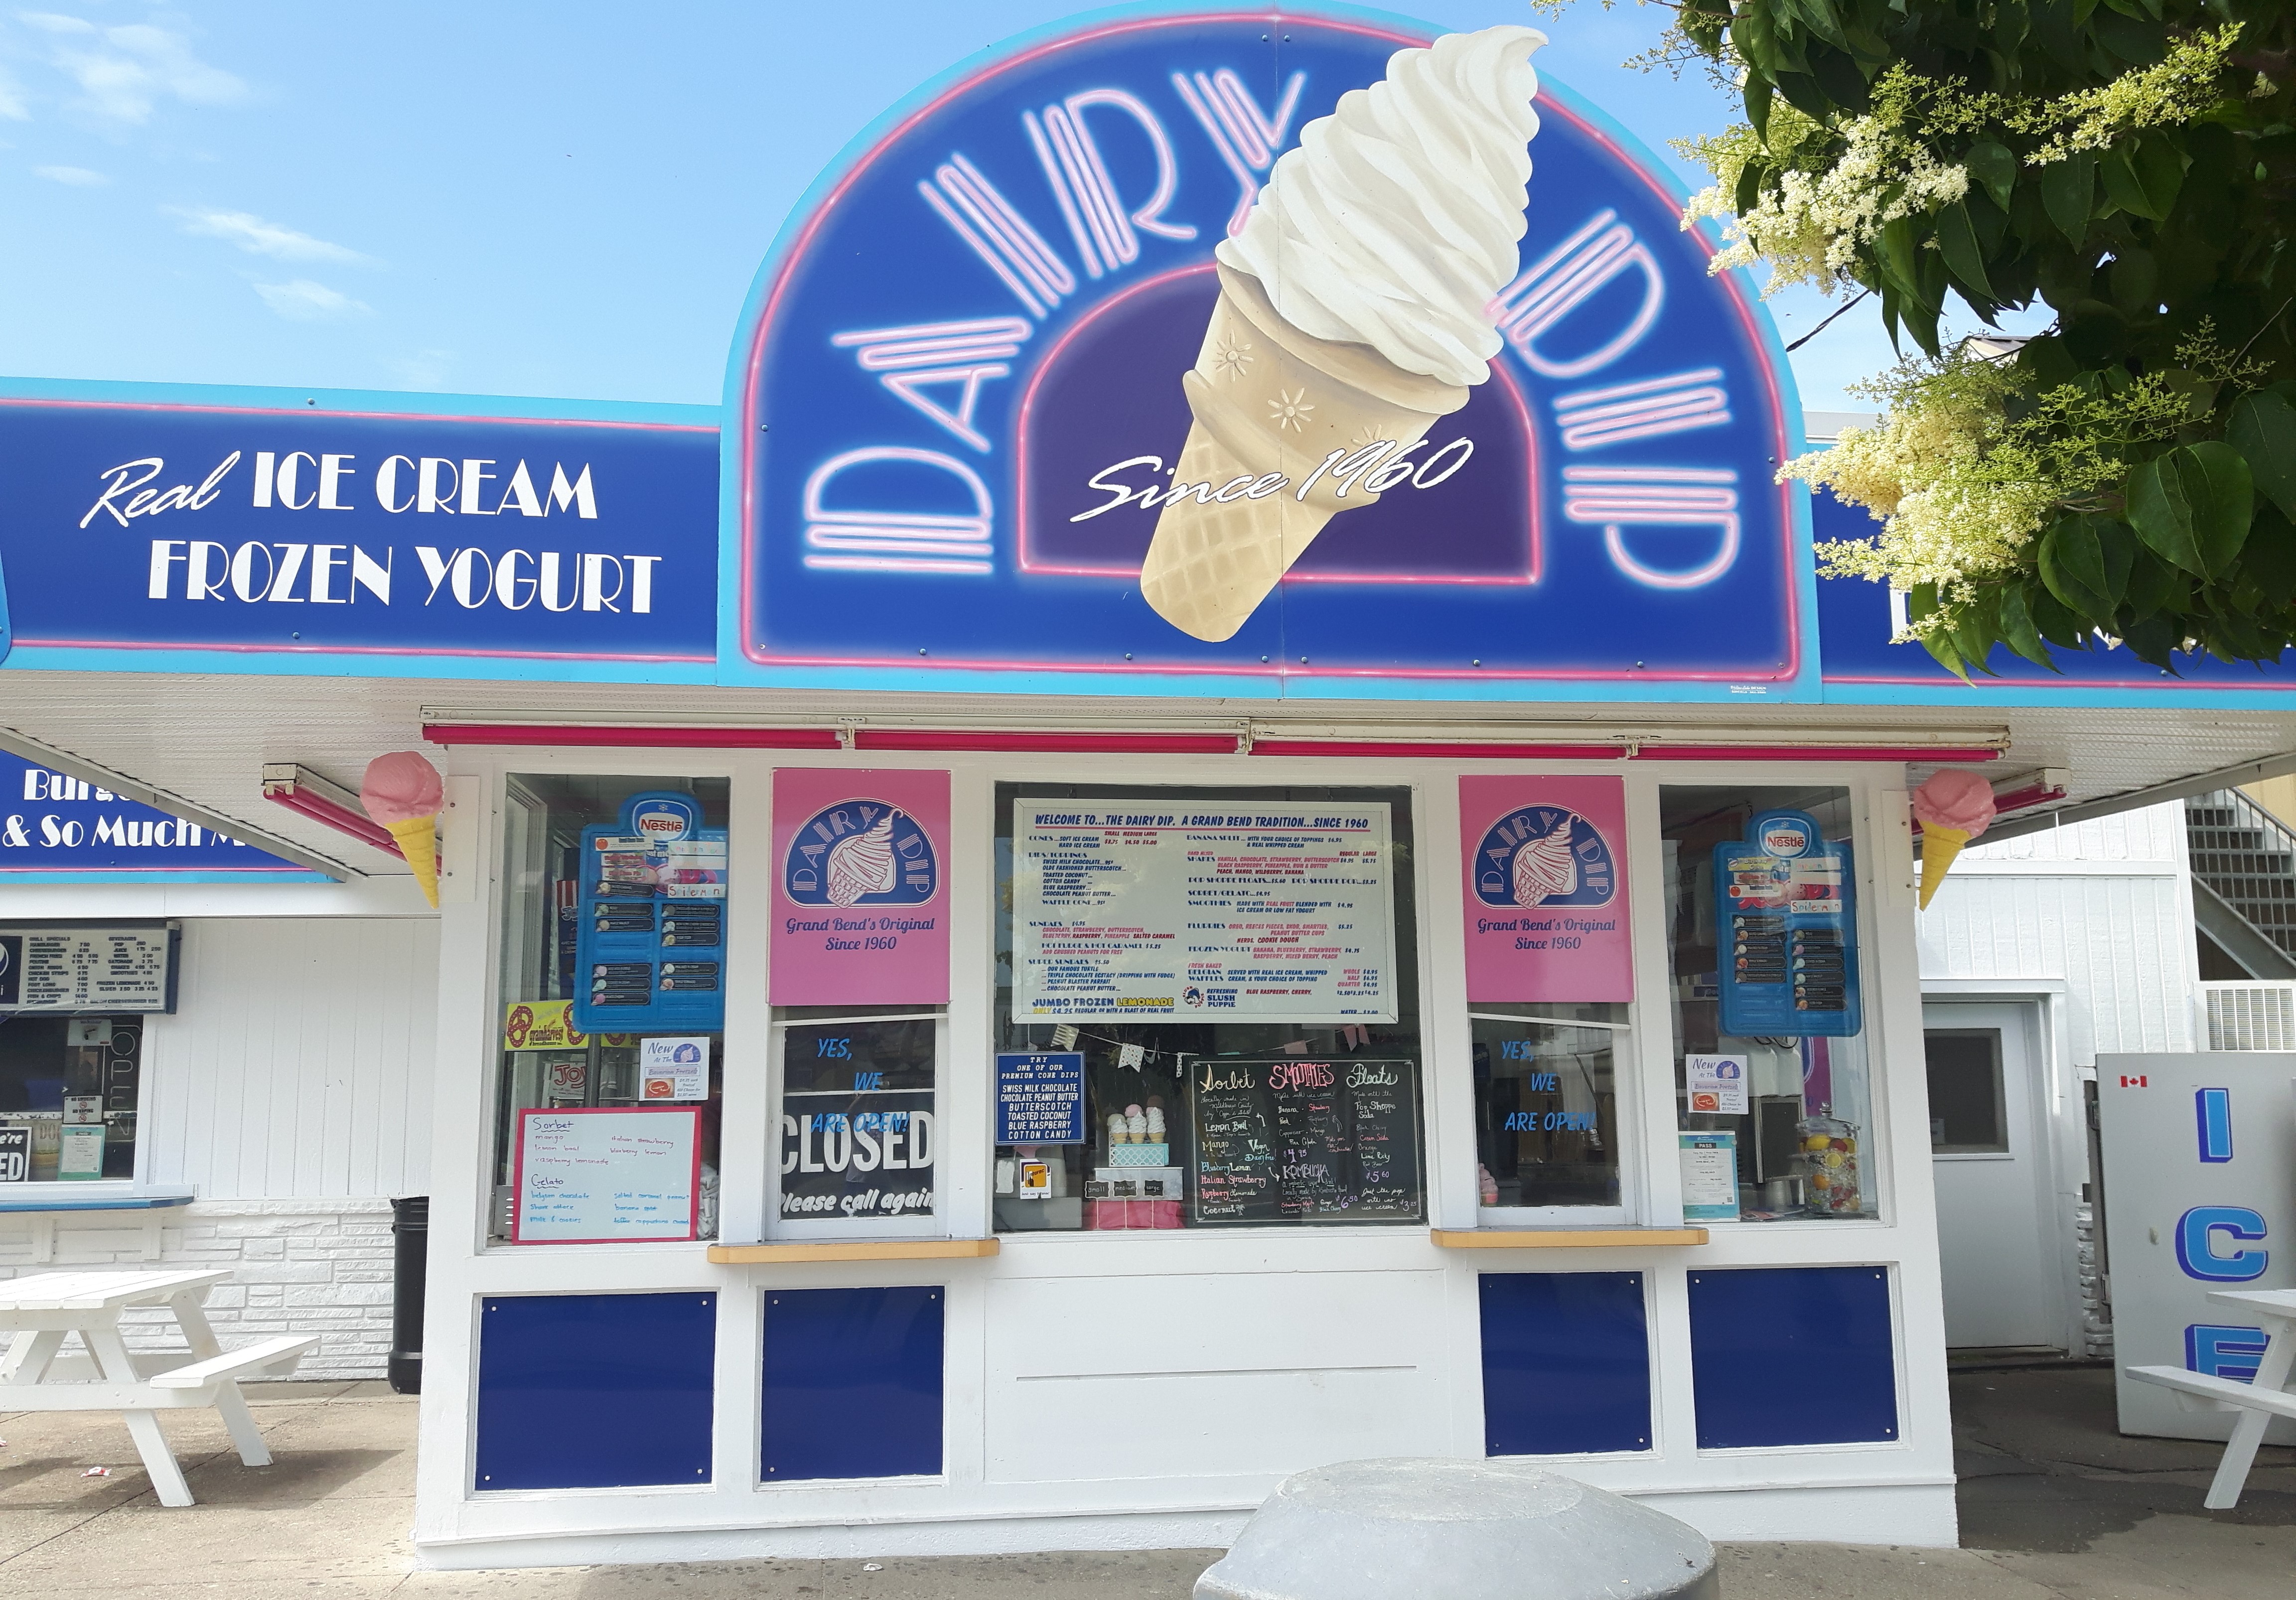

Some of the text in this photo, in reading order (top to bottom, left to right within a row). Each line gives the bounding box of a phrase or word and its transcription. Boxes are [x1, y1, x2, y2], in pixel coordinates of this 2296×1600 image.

[803, 67, 1739, 589] DAIRY DIP
[1070, 436, 1474, 522] Since 1960
[80, 450, 598, 529] Real ICE CREAM
[148, 540, 662, 613] FROZEN YOGURT
[24, 769, 131, 802] Burg
[1035, 815, 1083, 825] WELCOME
[1126, 816, 1154, 826] DAIRY
[1157, 816, 1175, 826] DIP.
[1191, 816, 1224, 826] GRAND
[1227, 816, 1252, 826] BEND
[1345, 819, 1368, 828] 1960
[2, 815, 30, 847] &
[40, 815, 84, 847] So
[92, 815, 201, 847] Much
[793, 806, 929, 892] DAIRY DIP
[1482, 811, 1609, 895] DAIRY DIP
[787, 917, 934, 934] Grand Bend's Original
[1478, 919, 1615, 934] Grand Bend's Original
[826, 937, 896, 950] Since 1960
[1515, 937, 1580, 950] Since 1960
[1032, 998, 1174, 1007] JUMBO FROZEN LEMONADE
[648, 1042, 674, 1055] New
[818, 1038, 853, 1061] YES,
[1501, 1040, 1534, 1062] YES,
[1693, 1058, 1716, 1069] New
[855, 1072, 883, 1091] WE
[1199, 1064, 1255, 1093] Sorbet
[1269, 1062, 1335, 1091] SMOOTHIES
[1346, 1063, 1398, 1088] Floats
[1041, 1083, 1077, 1092] CHOCOLATE
[1531, 1073, 1557, 1092] WE
[1001, 1093, 1078, 1102] CHOCOLATE PEANUT BUTTER
[1009, 1103, 1072, 1111] BUTTERSCOTCH
[1278, 1105, 1299, 1114] Banana
[1354, 1101, 1368, 1111] Pop
[1008, 1111, 1071, 1120] TOASTED COCONUT
[1504, 1112, 1596, 1132] ARE OPEN!
[533, 1118, 574, 1131] Sorbet
[811, 1113, 910, 1133] ARE OPEN!
[1008, 1121, 1071, 1130] BLUE RASPBERRY
[1205, 1123, 1230, 1132] Lemon
[0, 1132, 23, 1145] e're
[535, 1135, 564, 1144] mango
[1008, 1130, 1072, 1139] COTTON CANDY
[782, 1111, 934, 1174] CLOSED
[1202, 1141, 1229, 1154] Mango
[1358, 1143, 1377, 1153] Orange
[1229, 1163, 1252, 1171] Lemon
[1283, 1164, 1330, 1183] KOMBUCHA
[531, 1174, 564, 1186] Gelato
[1201, 1174, 1266, 1188] Italian Strawberry
[781, 1192, 835, 1213] lease
[841, 1188, 880, 1211] call
[1201, 1188, 1229, 1201] Raspberry
[1203, 1204, 1236, 1215] Coconut
[2175, 1088, 2271, 1385] ICE
